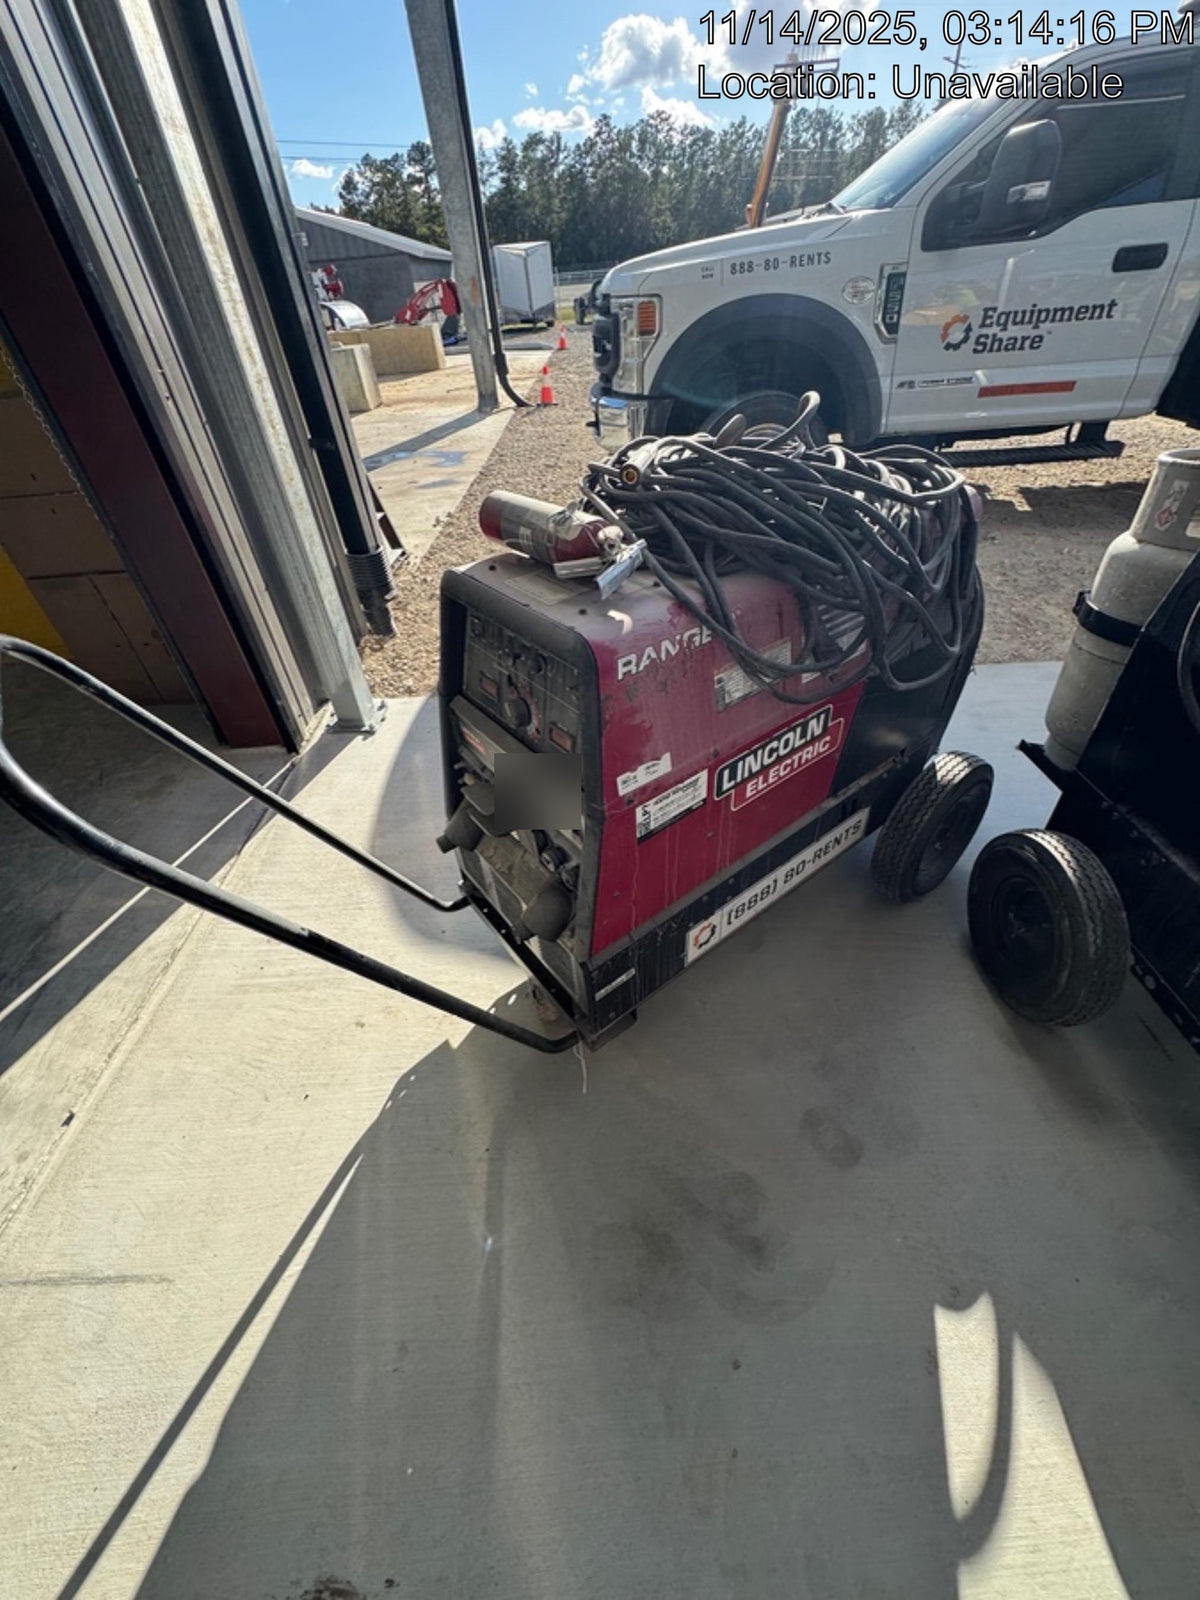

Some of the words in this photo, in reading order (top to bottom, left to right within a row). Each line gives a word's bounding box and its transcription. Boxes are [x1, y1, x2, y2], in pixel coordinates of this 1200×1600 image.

[729, 251, 832, 275] 888-80-RENTS
[978, 298, 1118, 332] Equipment
[972, 332, 1044, 354] Share
[617, 625, 712, 680] RANGE
[722, 713, 826, 791] LINCOLN
[745, 735, 831, 798] ELECTRIC
[783, 818, 863, 884] 80-RENTS
